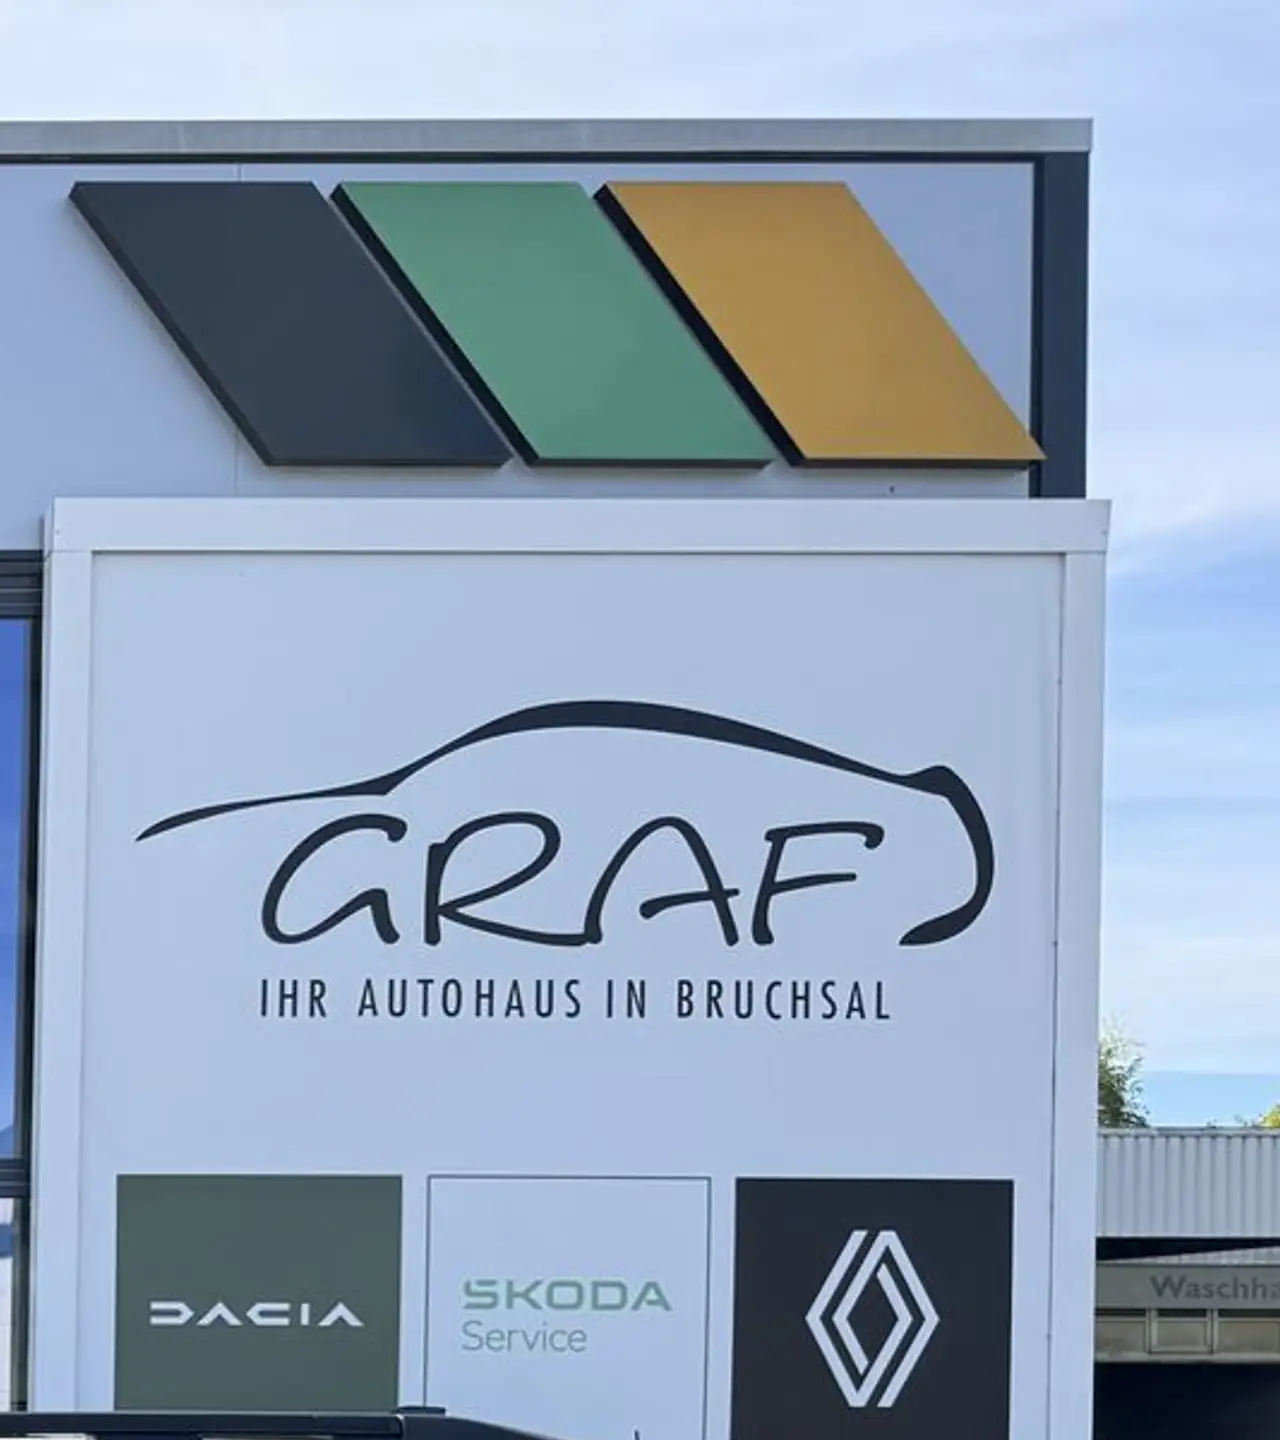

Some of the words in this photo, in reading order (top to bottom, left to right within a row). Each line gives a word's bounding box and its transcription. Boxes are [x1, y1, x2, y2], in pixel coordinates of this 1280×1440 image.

[261, 809, 886, 949] GRAF
[259, 977, 329, 1019] IHR
[357, 978, 583, 1021] AUTOHAUS
[604, 978, 647, 1021] IN
[676, 979, 893, 1022] BRUCHSAL
[148, 1301, 365, 1327] DACIA
[460, 1319, 589, 1353] Service
